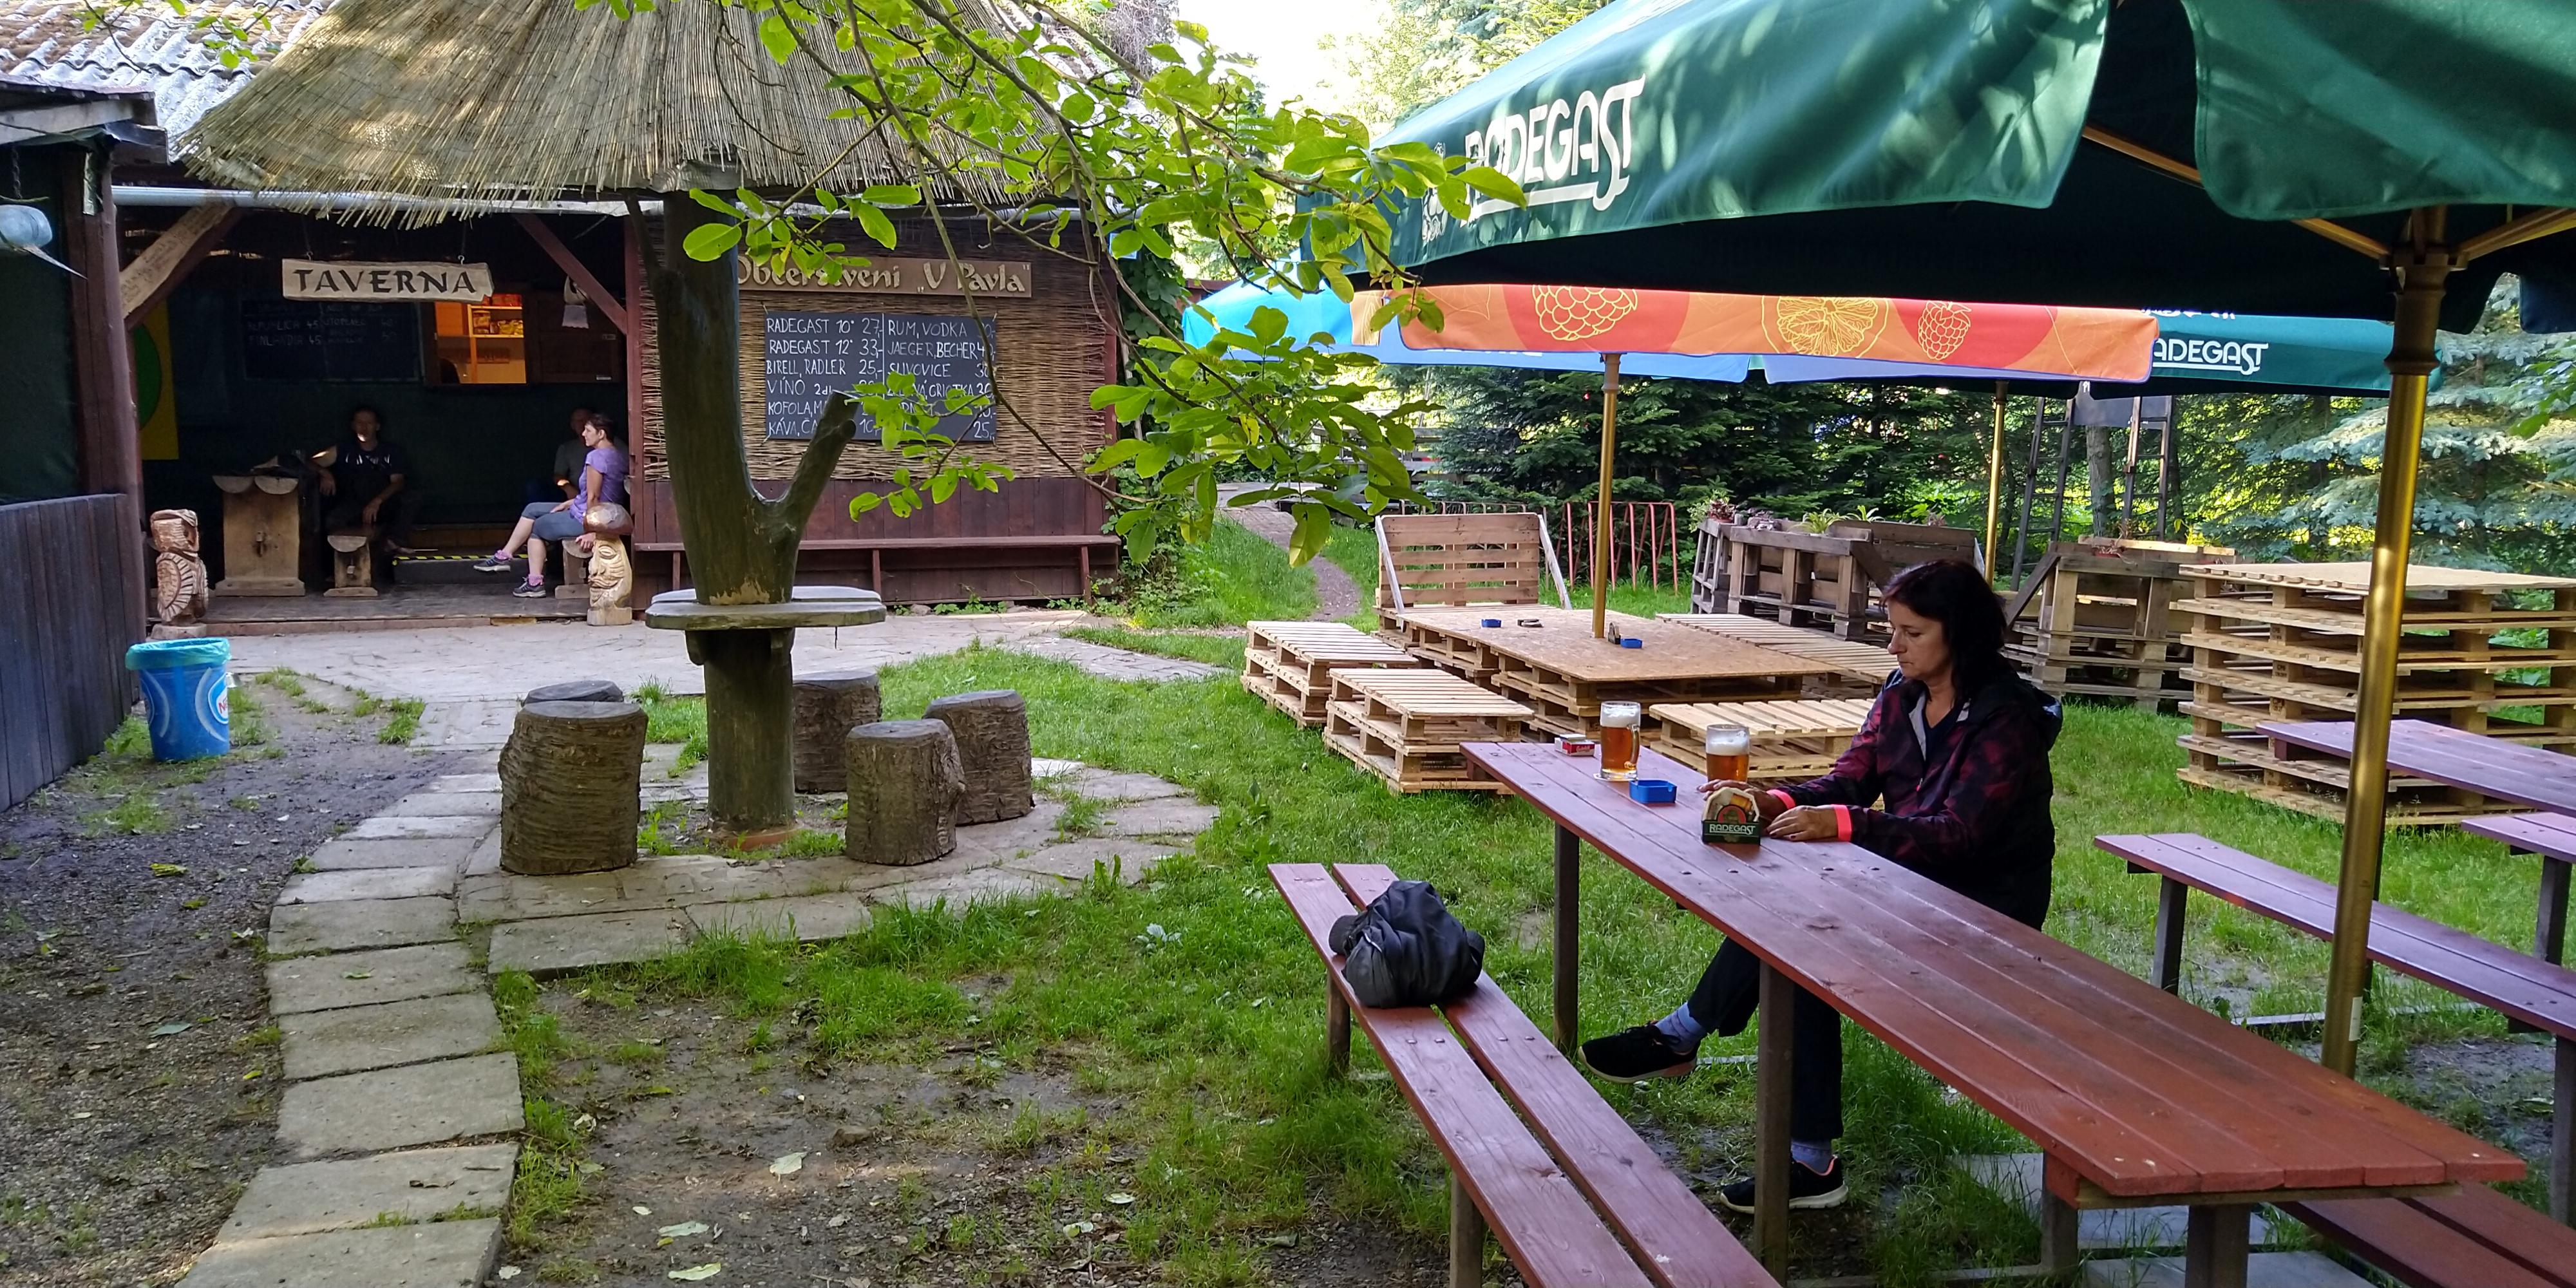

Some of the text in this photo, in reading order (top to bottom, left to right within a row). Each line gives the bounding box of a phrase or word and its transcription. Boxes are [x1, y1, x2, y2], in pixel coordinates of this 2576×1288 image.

[292, 269, 477, 294] TAVERNA
[766, 318, 829, 334] RADEGAST
[770, 340, 830, 355] RADEGAST
[2153, 338, 2269, 375] ADEGAST
[804, 359, 846, 375] RADLER
[767, 376, 805, 395] VÍNO
[1709, 824, 1756, 835] RADEGAST
